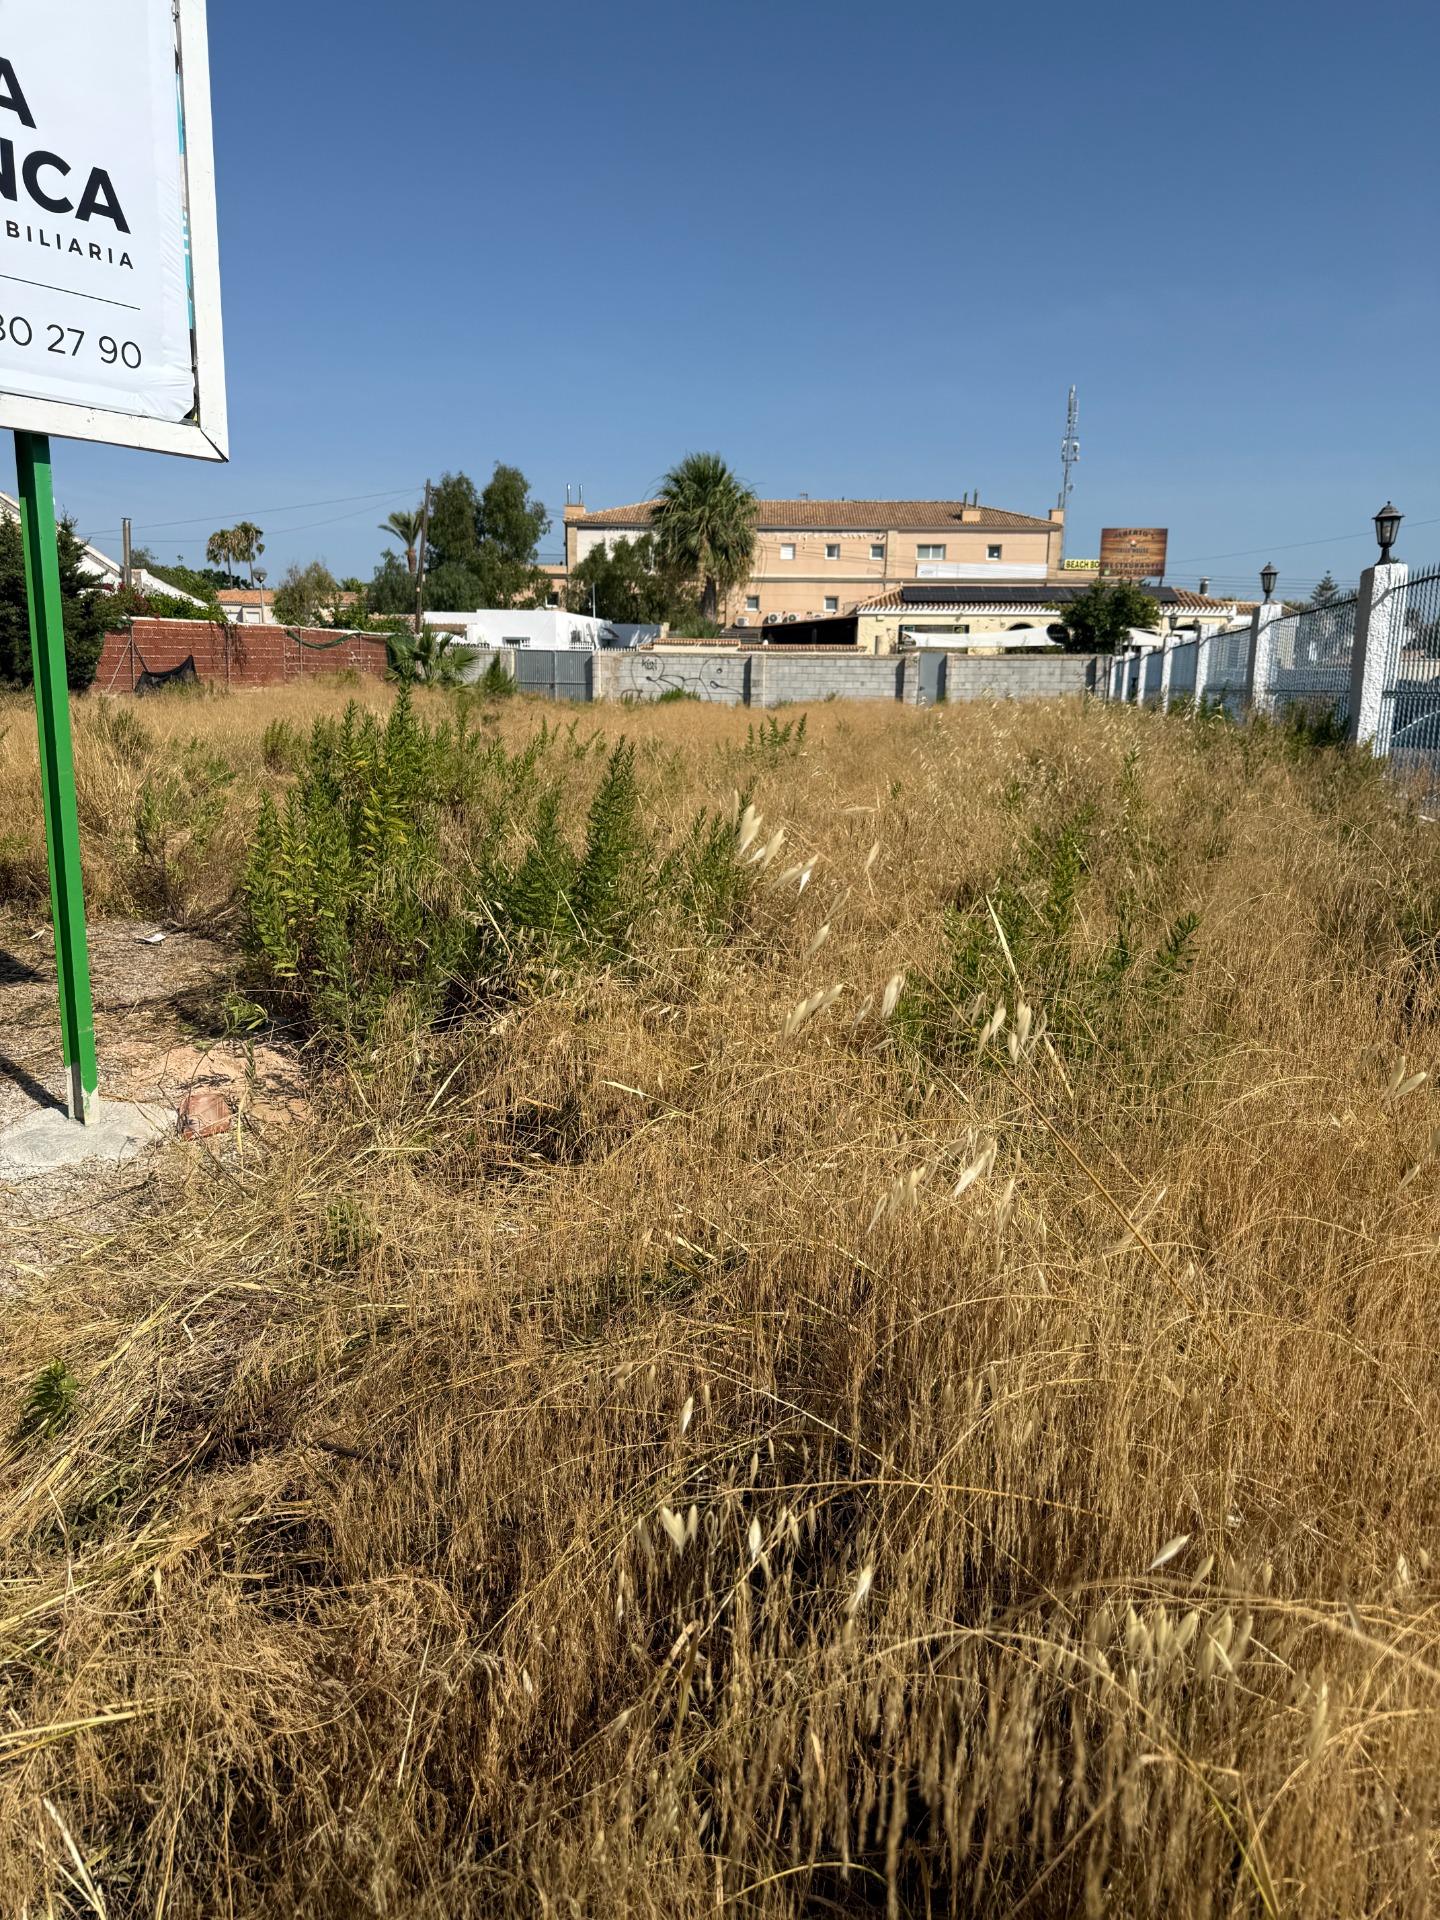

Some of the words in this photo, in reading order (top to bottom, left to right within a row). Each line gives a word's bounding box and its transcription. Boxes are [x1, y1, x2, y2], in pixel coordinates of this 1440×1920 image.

[6, 220, 134, 270] BILIARIA
[47, 324, 85, 356] 27
[99, 336, 141, 369] 90
[1066, 561, 1089, 569] BEACH
